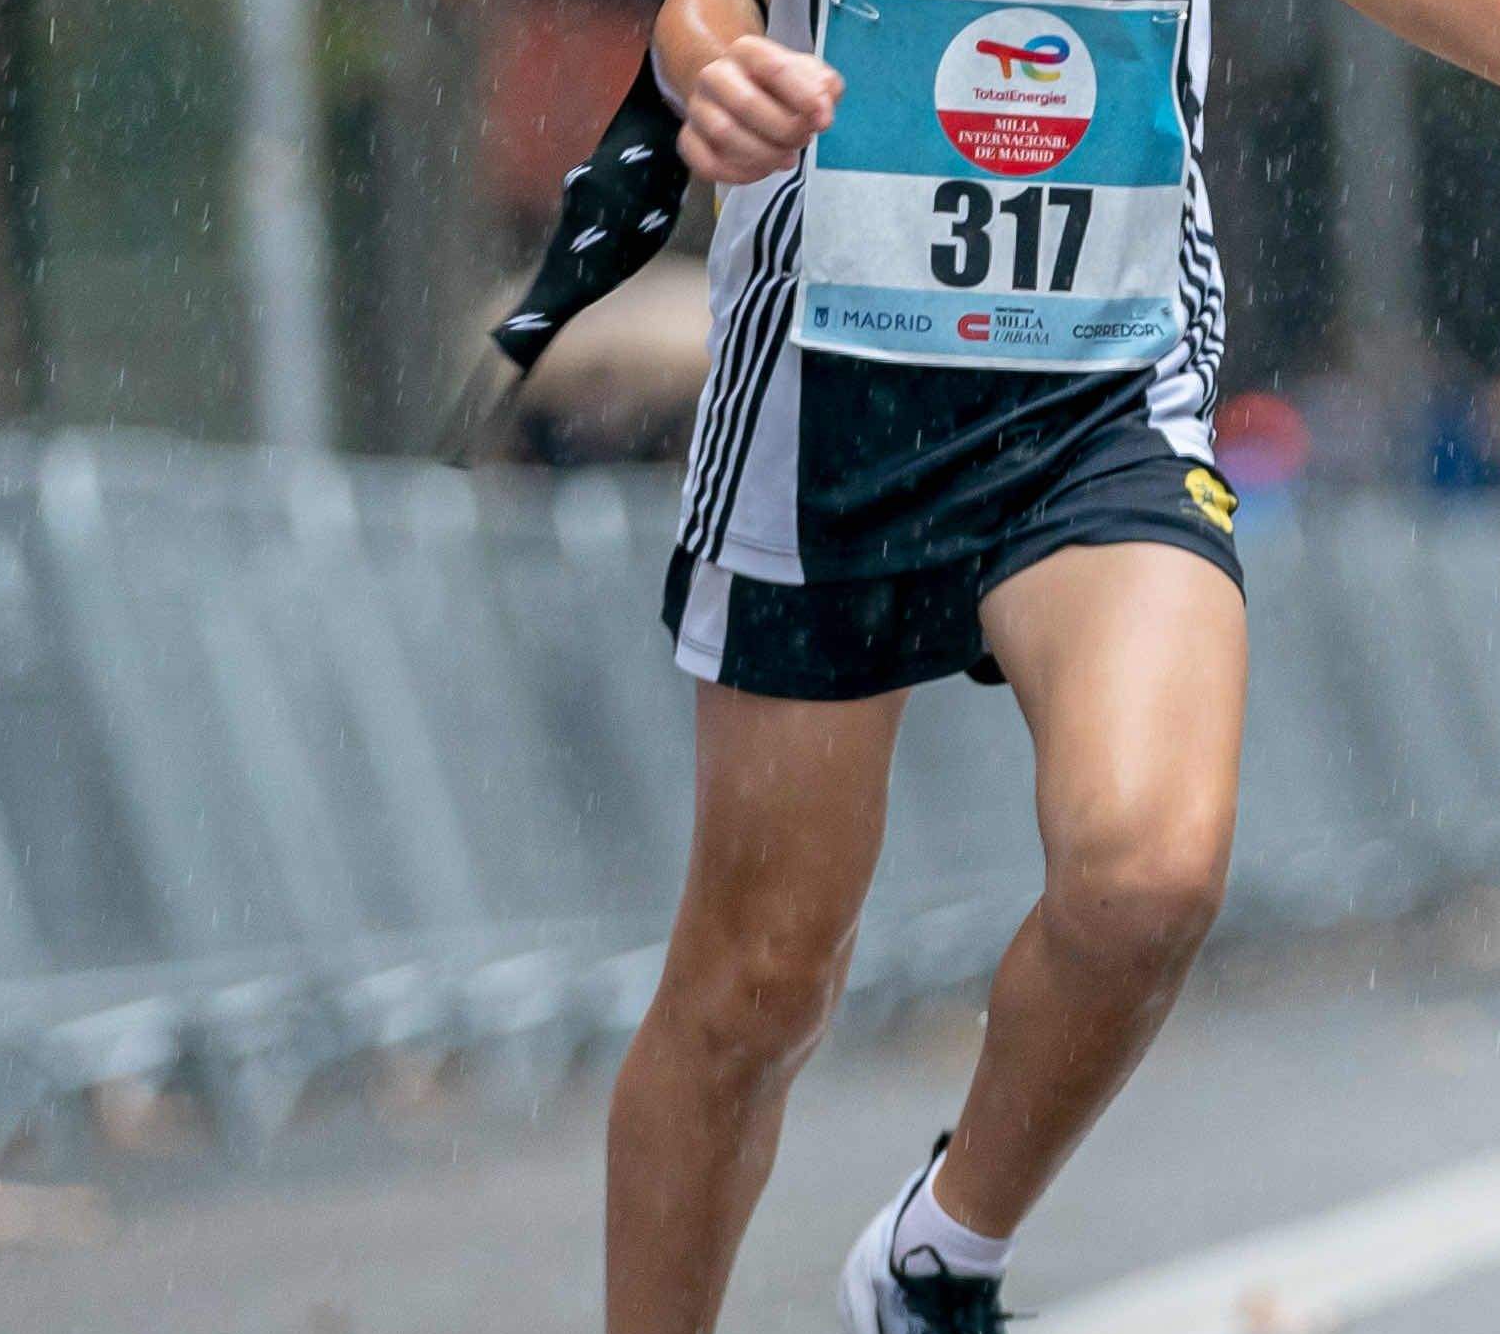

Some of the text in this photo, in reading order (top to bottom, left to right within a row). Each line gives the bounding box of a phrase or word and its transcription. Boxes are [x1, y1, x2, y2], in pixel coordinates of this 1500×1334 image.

[973, 87, 1067, 106] TotalEnergies
[994, 118, 1040, 132] MILLA
[974, 146, 1054, 162] DE MADRID
[930, 179, 1094, 293] 317
[842, 310, 933, 333] MADRID
[995, 314, 1044, 330] MILLA
